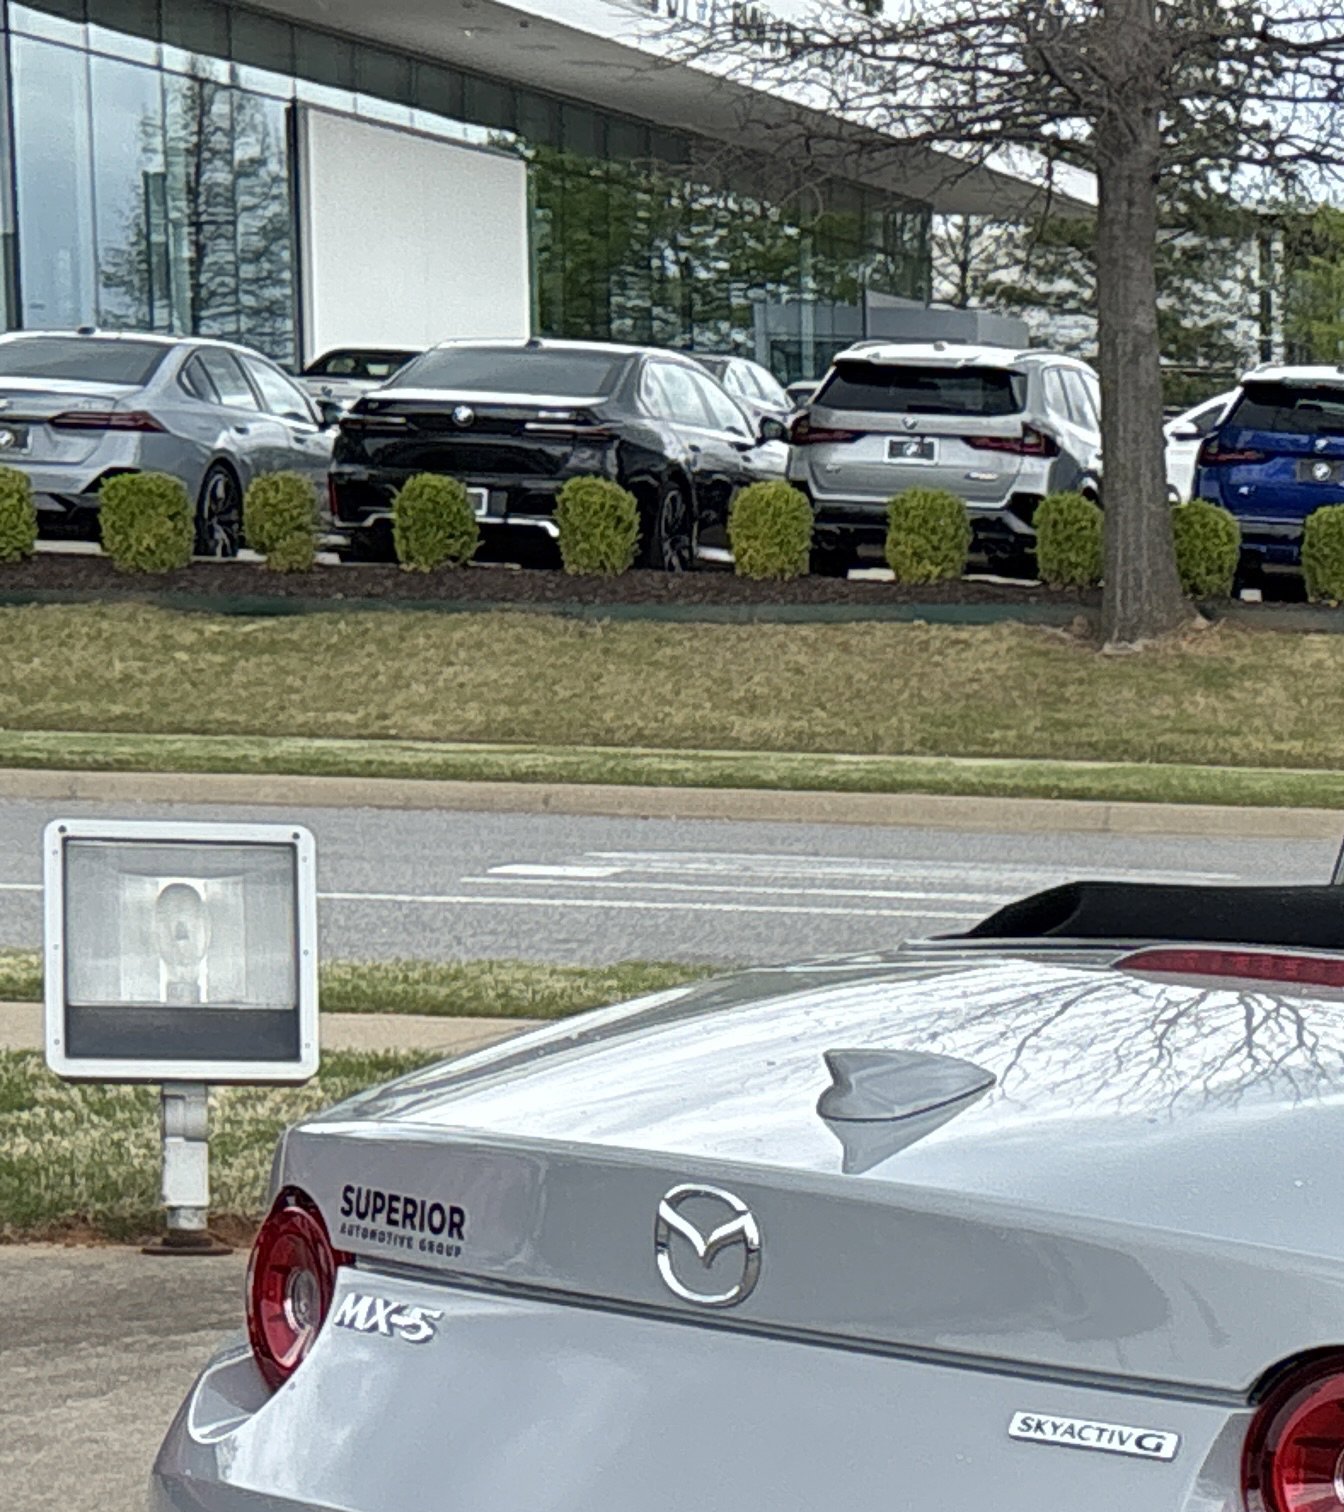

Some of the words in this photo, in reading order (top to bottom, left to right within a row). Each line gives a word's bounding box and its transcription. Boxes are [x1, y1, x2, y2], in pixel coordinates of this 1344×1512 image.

[340, 1184, 465, 1241] SUPERIOR
[339, 1222, 414, 1250] AUTOMOTIVE
[419, 1238, 462, 1258] GROUP
[334, 1292, 443, 1342] MX-5
[1017, 1416, 1133, 1446] SKYACTIV
